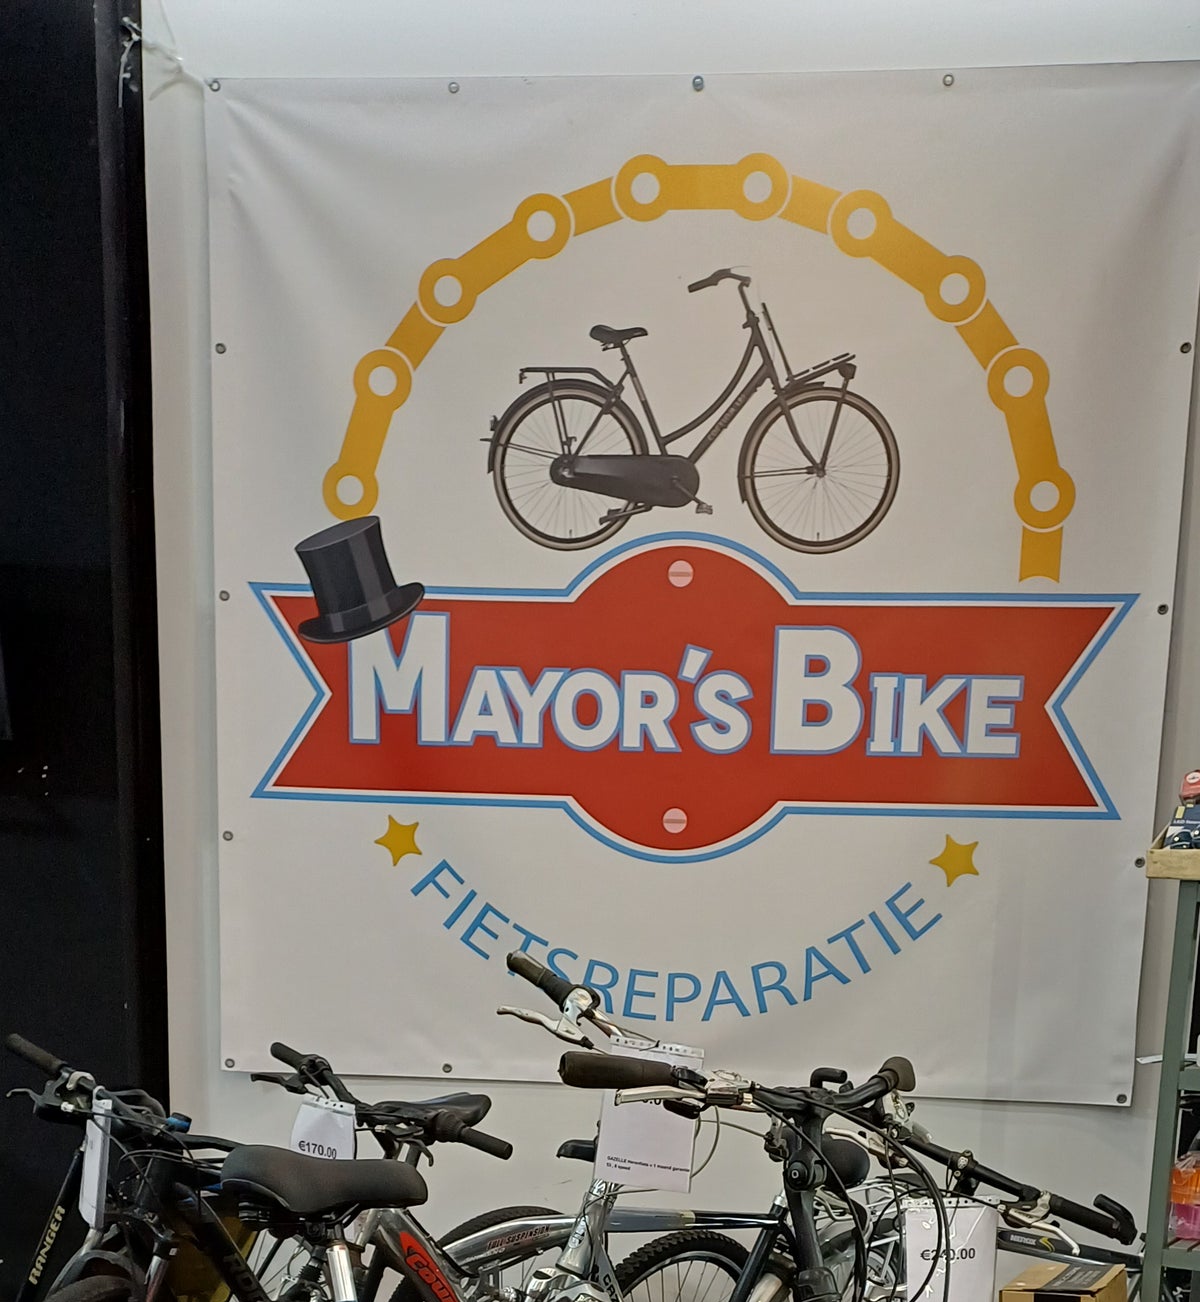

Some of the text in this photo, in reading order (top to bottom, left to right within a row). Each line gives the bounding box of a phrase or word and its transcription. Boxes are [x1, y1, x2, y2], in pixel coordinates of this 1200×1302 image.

[348, 611, 1025, 758] MAYOR'S BIKE
[411, 859, 943, 1022] FIETSREPARATIE
[298, 1140, 338, 1160] €170.00
[28, 1205, 65, 1285] RANGER
